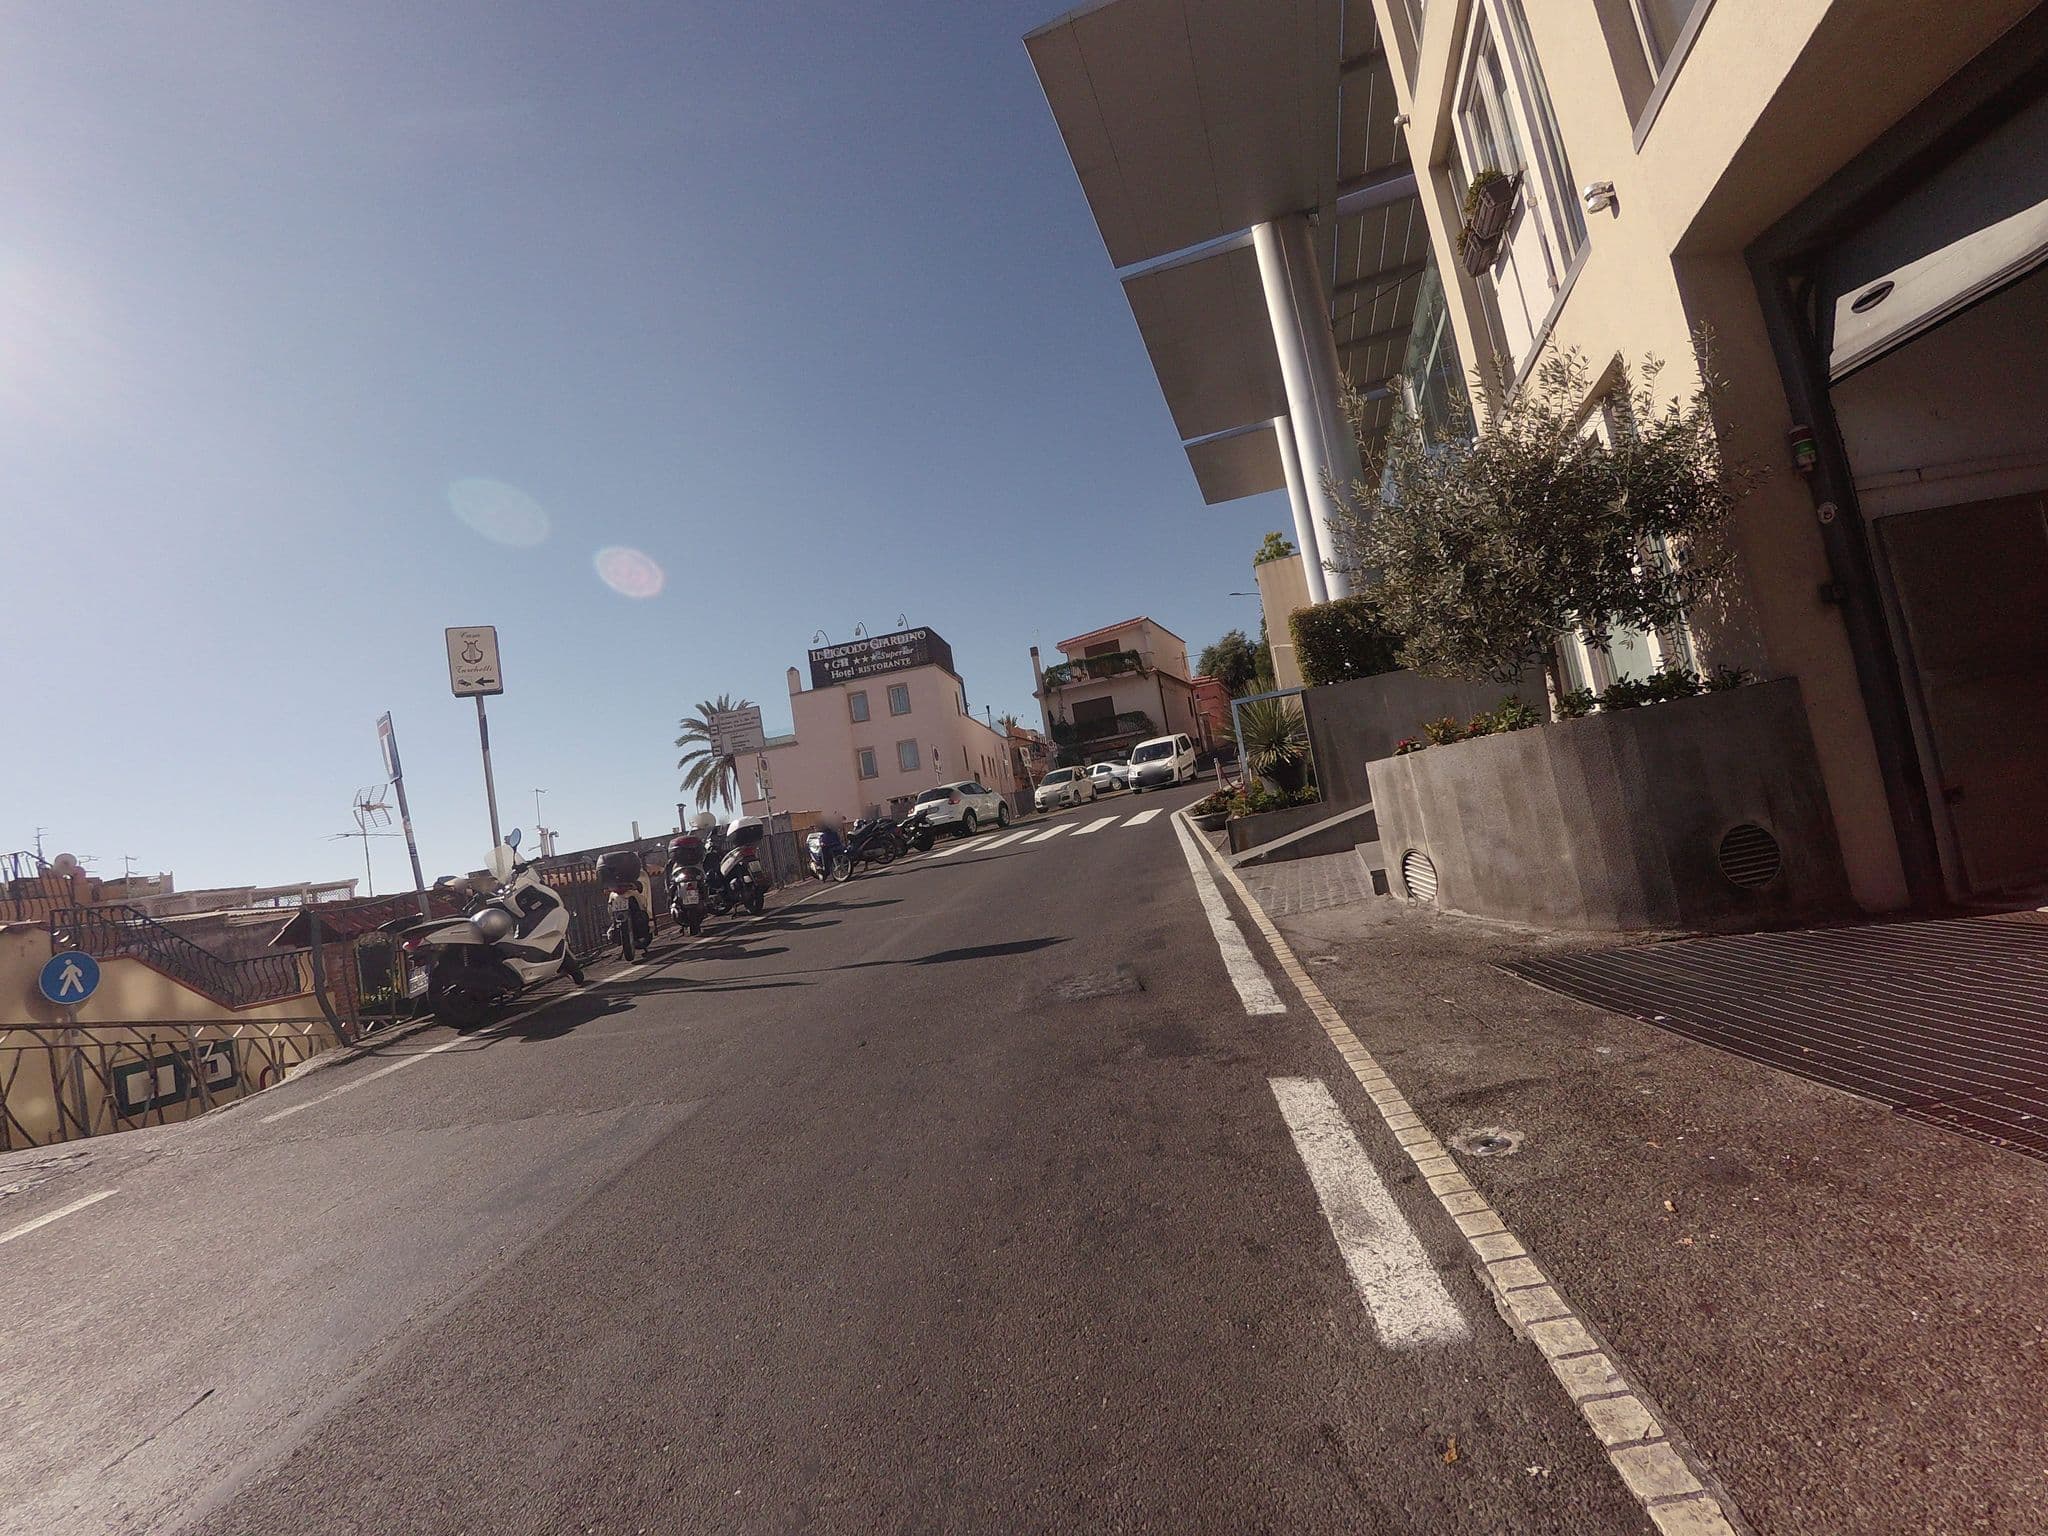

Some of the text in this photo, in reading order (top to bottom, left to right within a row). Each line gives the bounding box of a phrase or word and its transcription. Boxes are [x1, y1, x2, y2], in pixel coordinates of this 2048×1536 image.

[812, 630, 926, 662] IL PICCOLO GIARDINO
[831, 658, 912, 679] Hotel RISTORANTE
